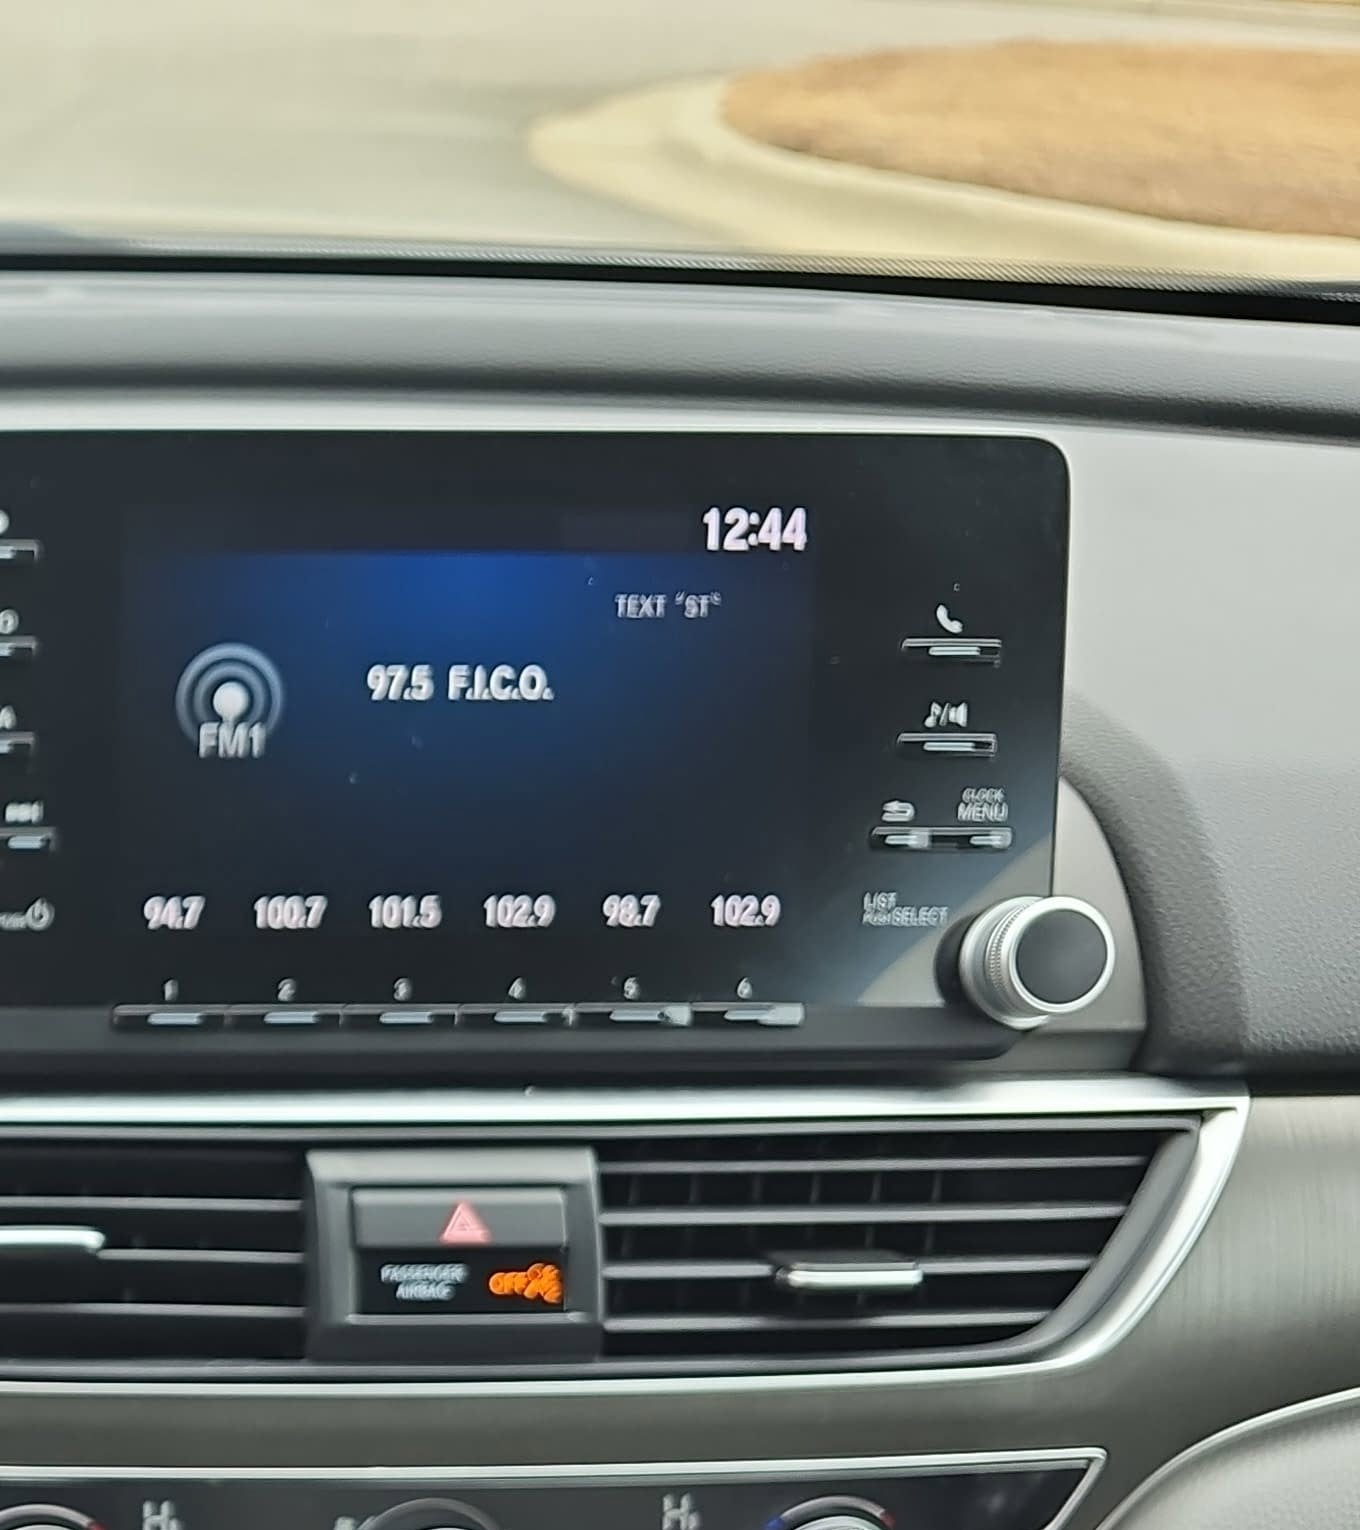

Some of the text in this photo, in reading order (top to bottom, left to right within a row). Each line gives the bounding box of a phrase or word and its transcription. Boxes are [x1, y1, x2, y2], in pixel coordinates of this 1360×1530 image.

[702, 506, 808, 552] 12:44
[615, 592, 667, 618] TEXT
[366, 663, 555, 701] 97.5 F.I.C.O.
[197, 721, 267, 759] FM1
[957, 802, 1009, 822] MENU
[142, 894, 206, 929] 94.7
[253, 894, 328, 929] 100.7
[368, 894, 443, 929] 101.5
[482, 894, 557, 929] 102.9
[602, 894, 662, 929] 98.7
[710, 894, 782, 929] 102.9
[863, 891, 897, 911] LIST
[891, 905, 950, 928] SELECT
[277, 977, 297, 1001] 2
[393, 977, 413, 1001] 3
